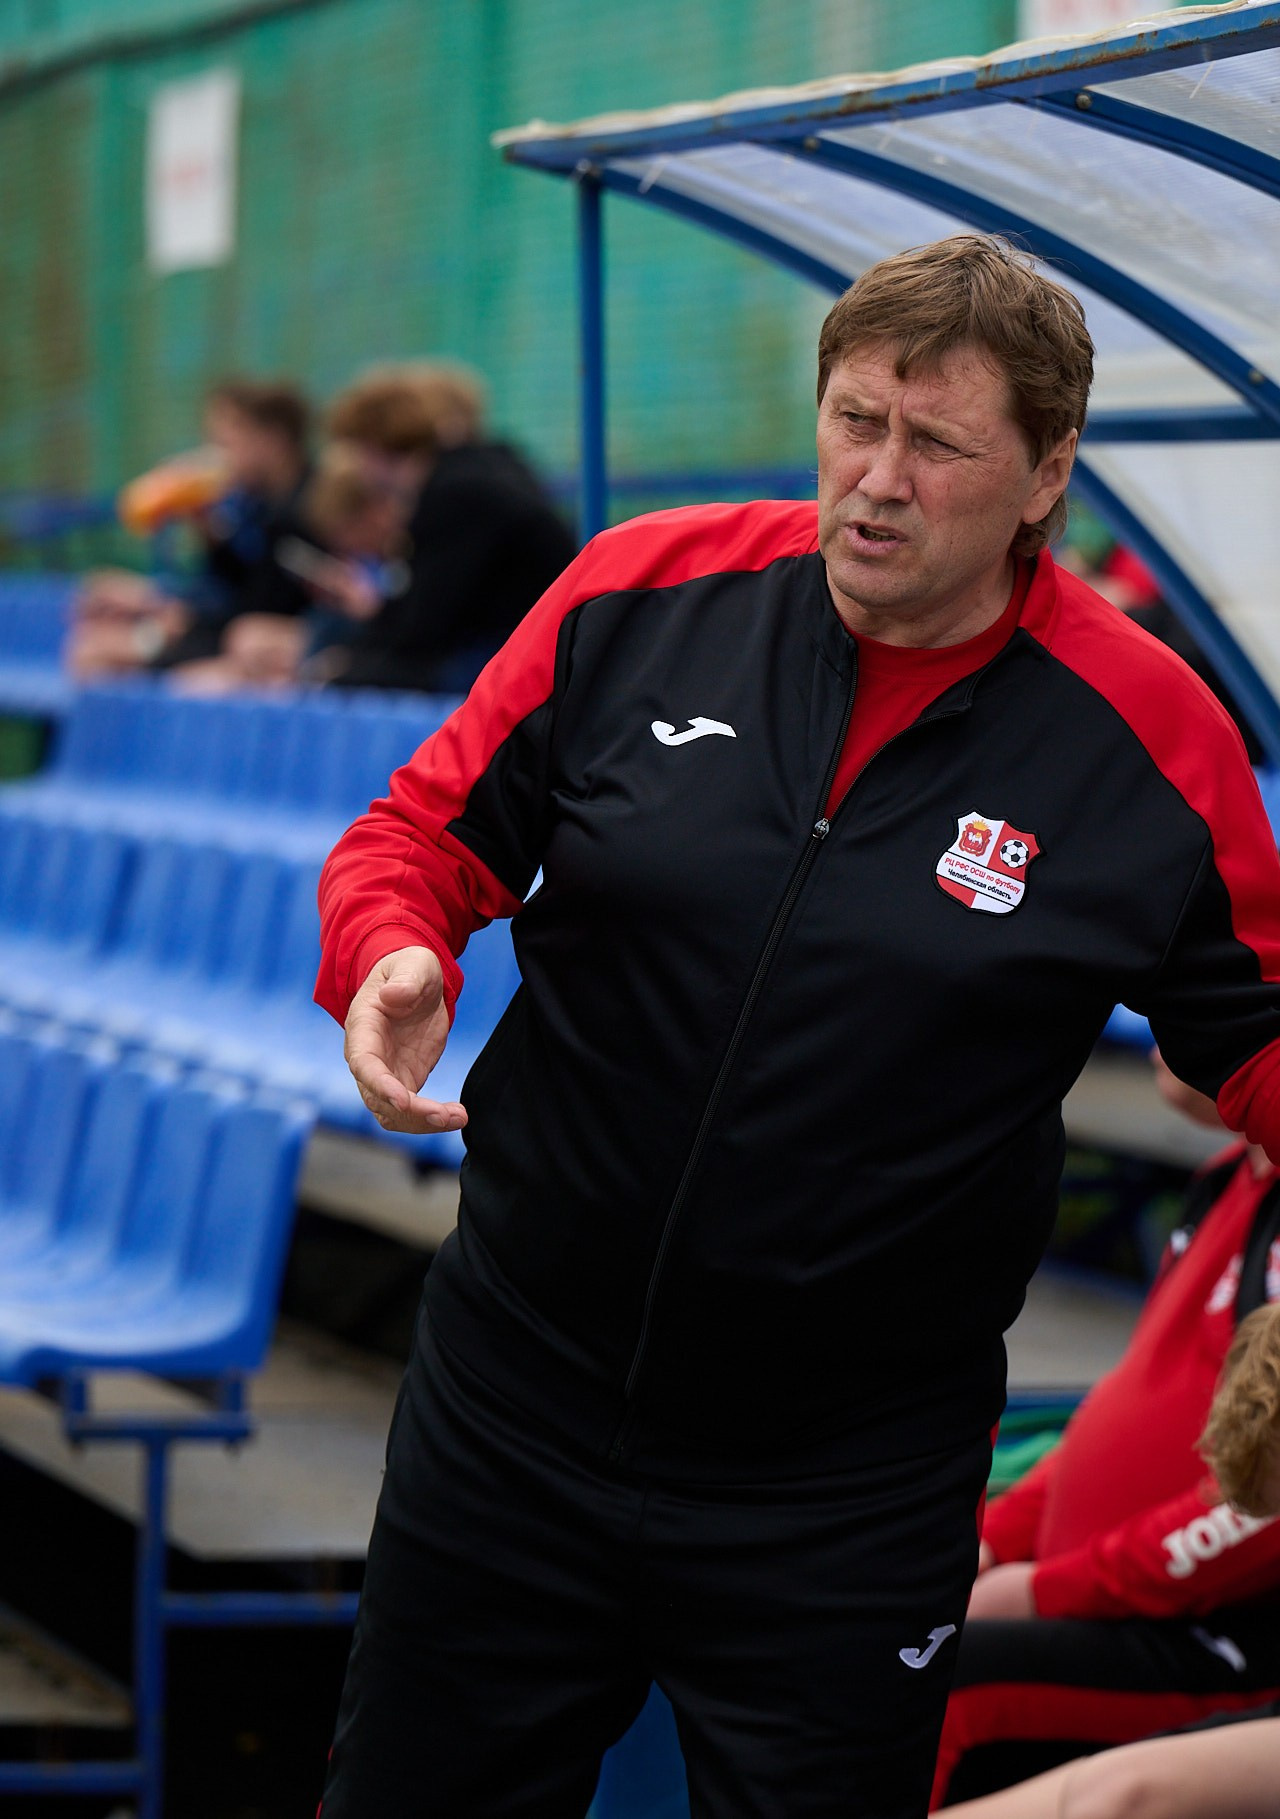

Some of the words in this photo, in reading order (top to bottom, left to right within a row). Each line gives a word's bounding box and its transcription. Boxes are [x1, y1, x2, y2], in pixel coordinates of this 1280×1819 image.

[948, 868, 987, 889] Челябинская
[987, 885, 1012, 900] область
[954, 860, 970, 872] РФС
[970, 867, 986, 879] ОСШ
[986, 874, 995, 882] по
